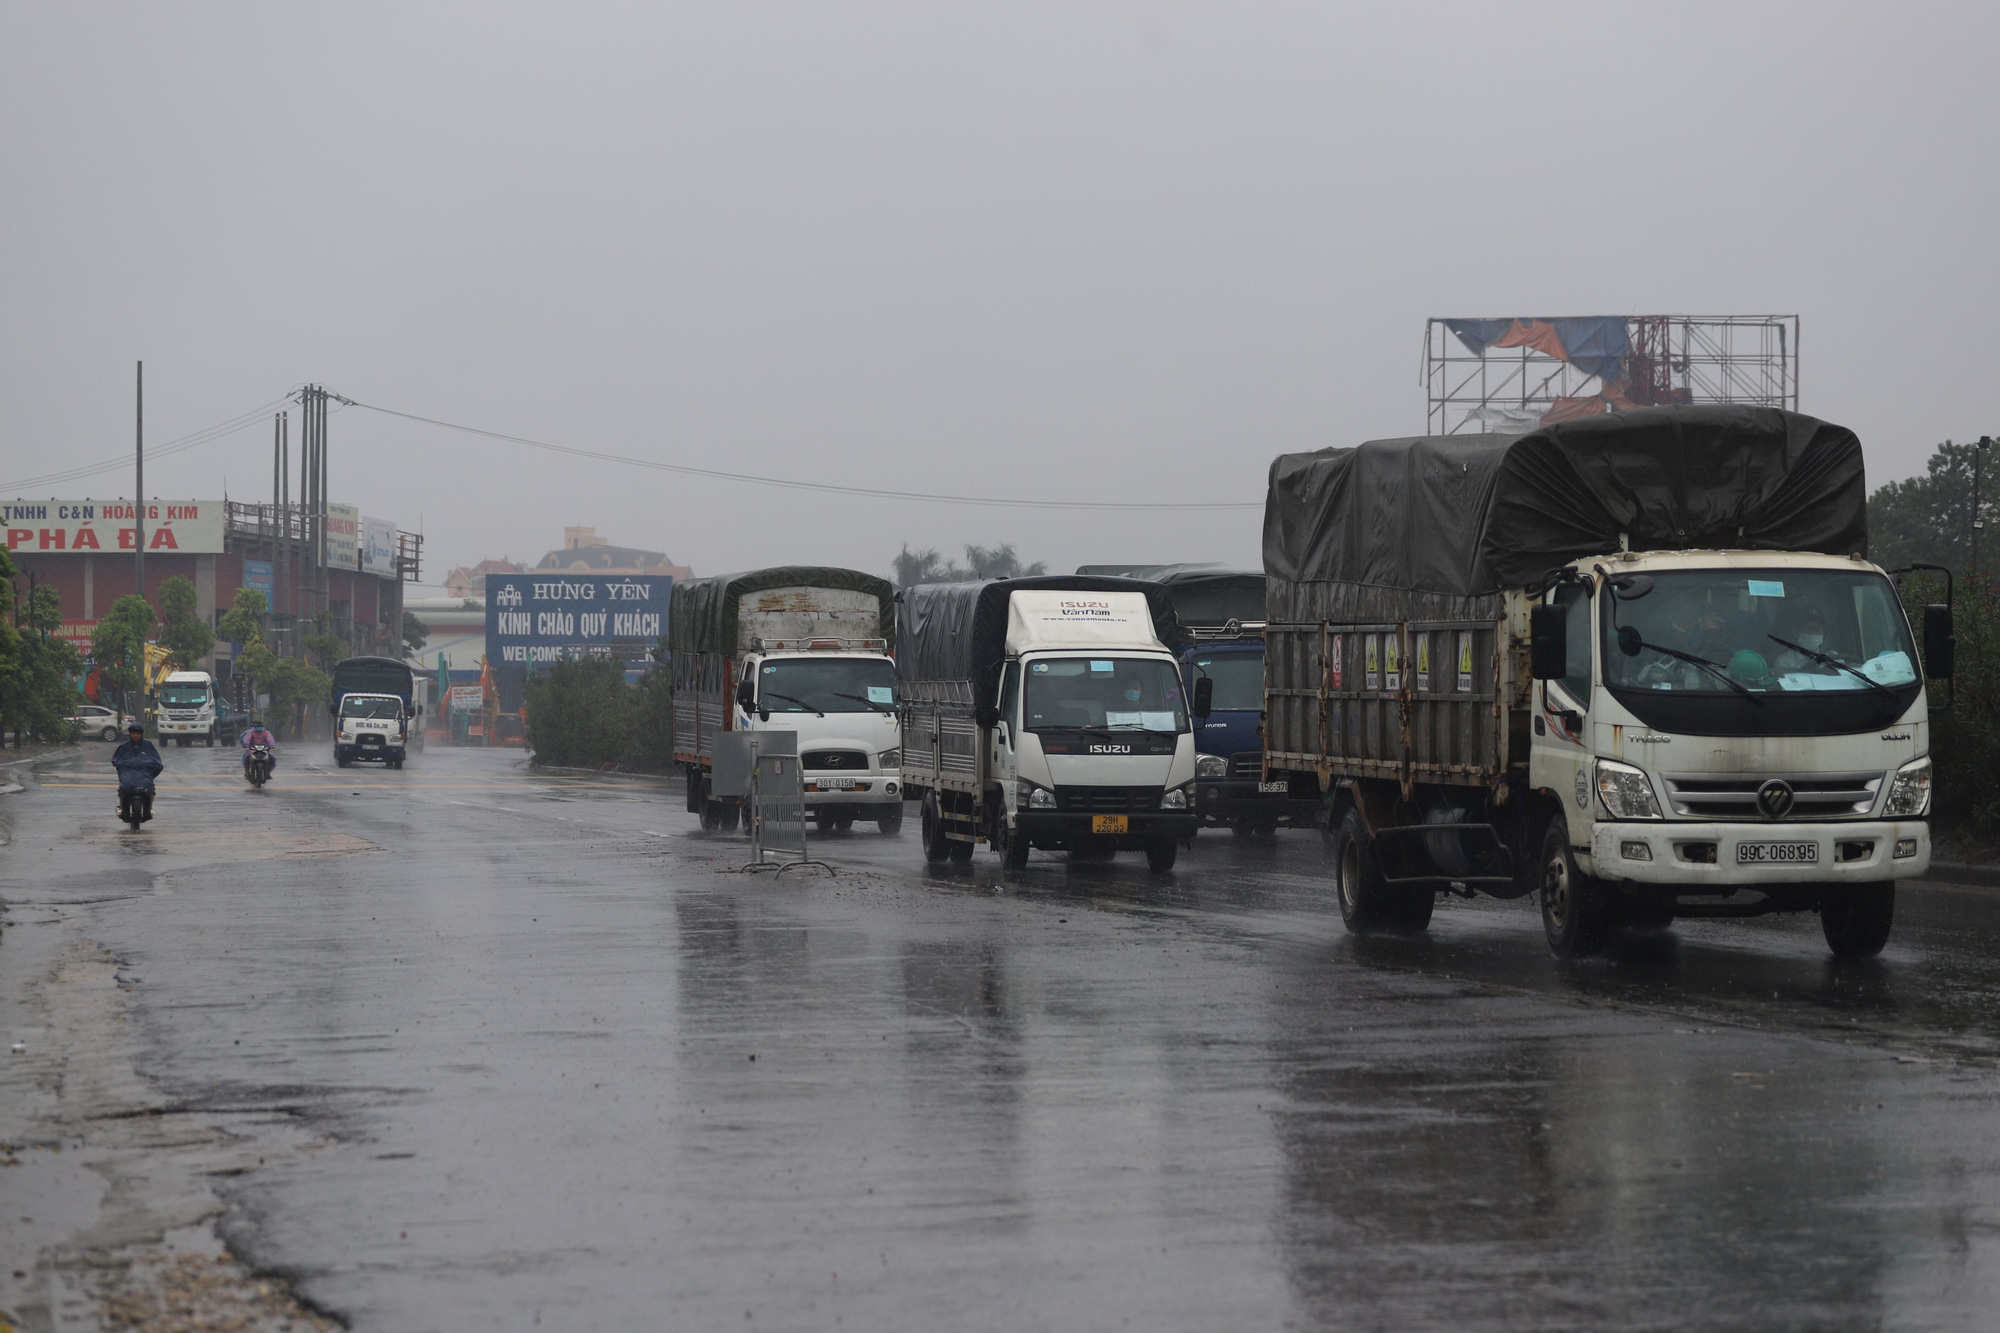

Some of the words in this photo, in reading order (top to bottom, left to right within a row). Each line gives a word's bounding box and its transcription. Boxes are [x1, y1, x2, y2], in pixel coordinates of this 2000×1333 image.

[3, 506, 47, 519] TNHH
[59, 506, 94, 519] C&N
[167, 506, 198, 519] KIM
[7, 521, 101, 549] PHÁ
[117, 521, 179, 549] ĐÁ
[533, 580, 595, 600] HƯNG
[605, 578, 651, 600] YÊN
[498, 607, 531, 635] KÍNH
[538, 607, 574, 635] CHÀO
[580, 608, 607, 638] QUÝ
[613, 608, 660, 636] KHÁCH
[502, 646, 563, 662] WELCOME
[1627, 734, 1671, 743] THACO
[1881, 733, 1911, 741] OLLIN
[1089, 745, 1131, 753] ISUZU
[1102, 816, 1119, 824] 29H
[1096, 824, 1125, 833] 220.02
[1740, 844, 1815, 860] 99C-068.95
